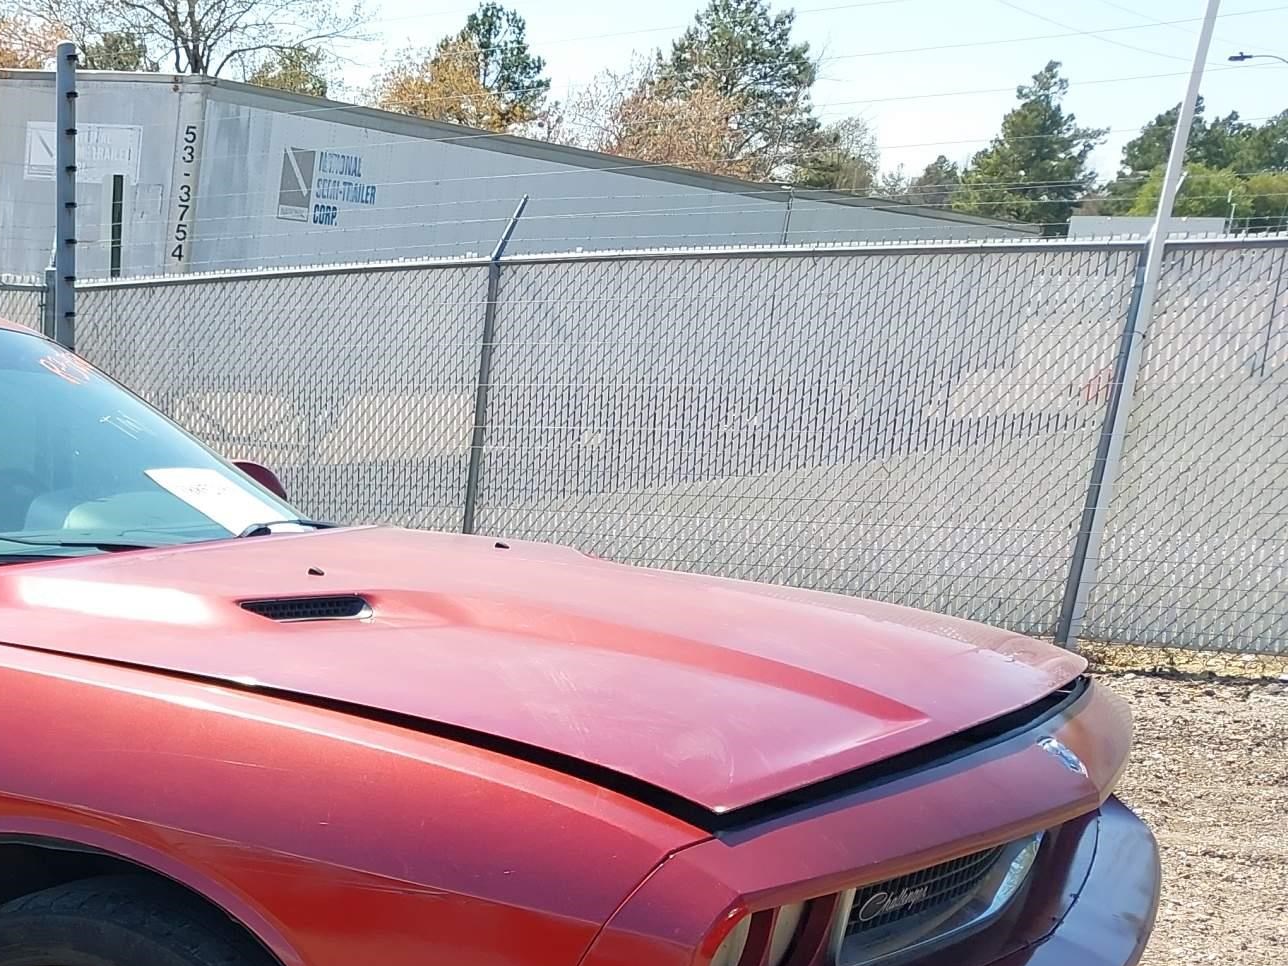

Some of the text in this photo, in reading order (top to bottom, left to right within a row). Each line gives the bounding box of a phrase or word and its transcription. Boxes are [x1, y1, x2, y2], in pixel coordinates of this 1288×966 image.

[318, 151, 362, 178] NATIONAL
[315, 178, 377, 206] SEMI-TRAILER
[312, 203, 338, 227] CORP.
